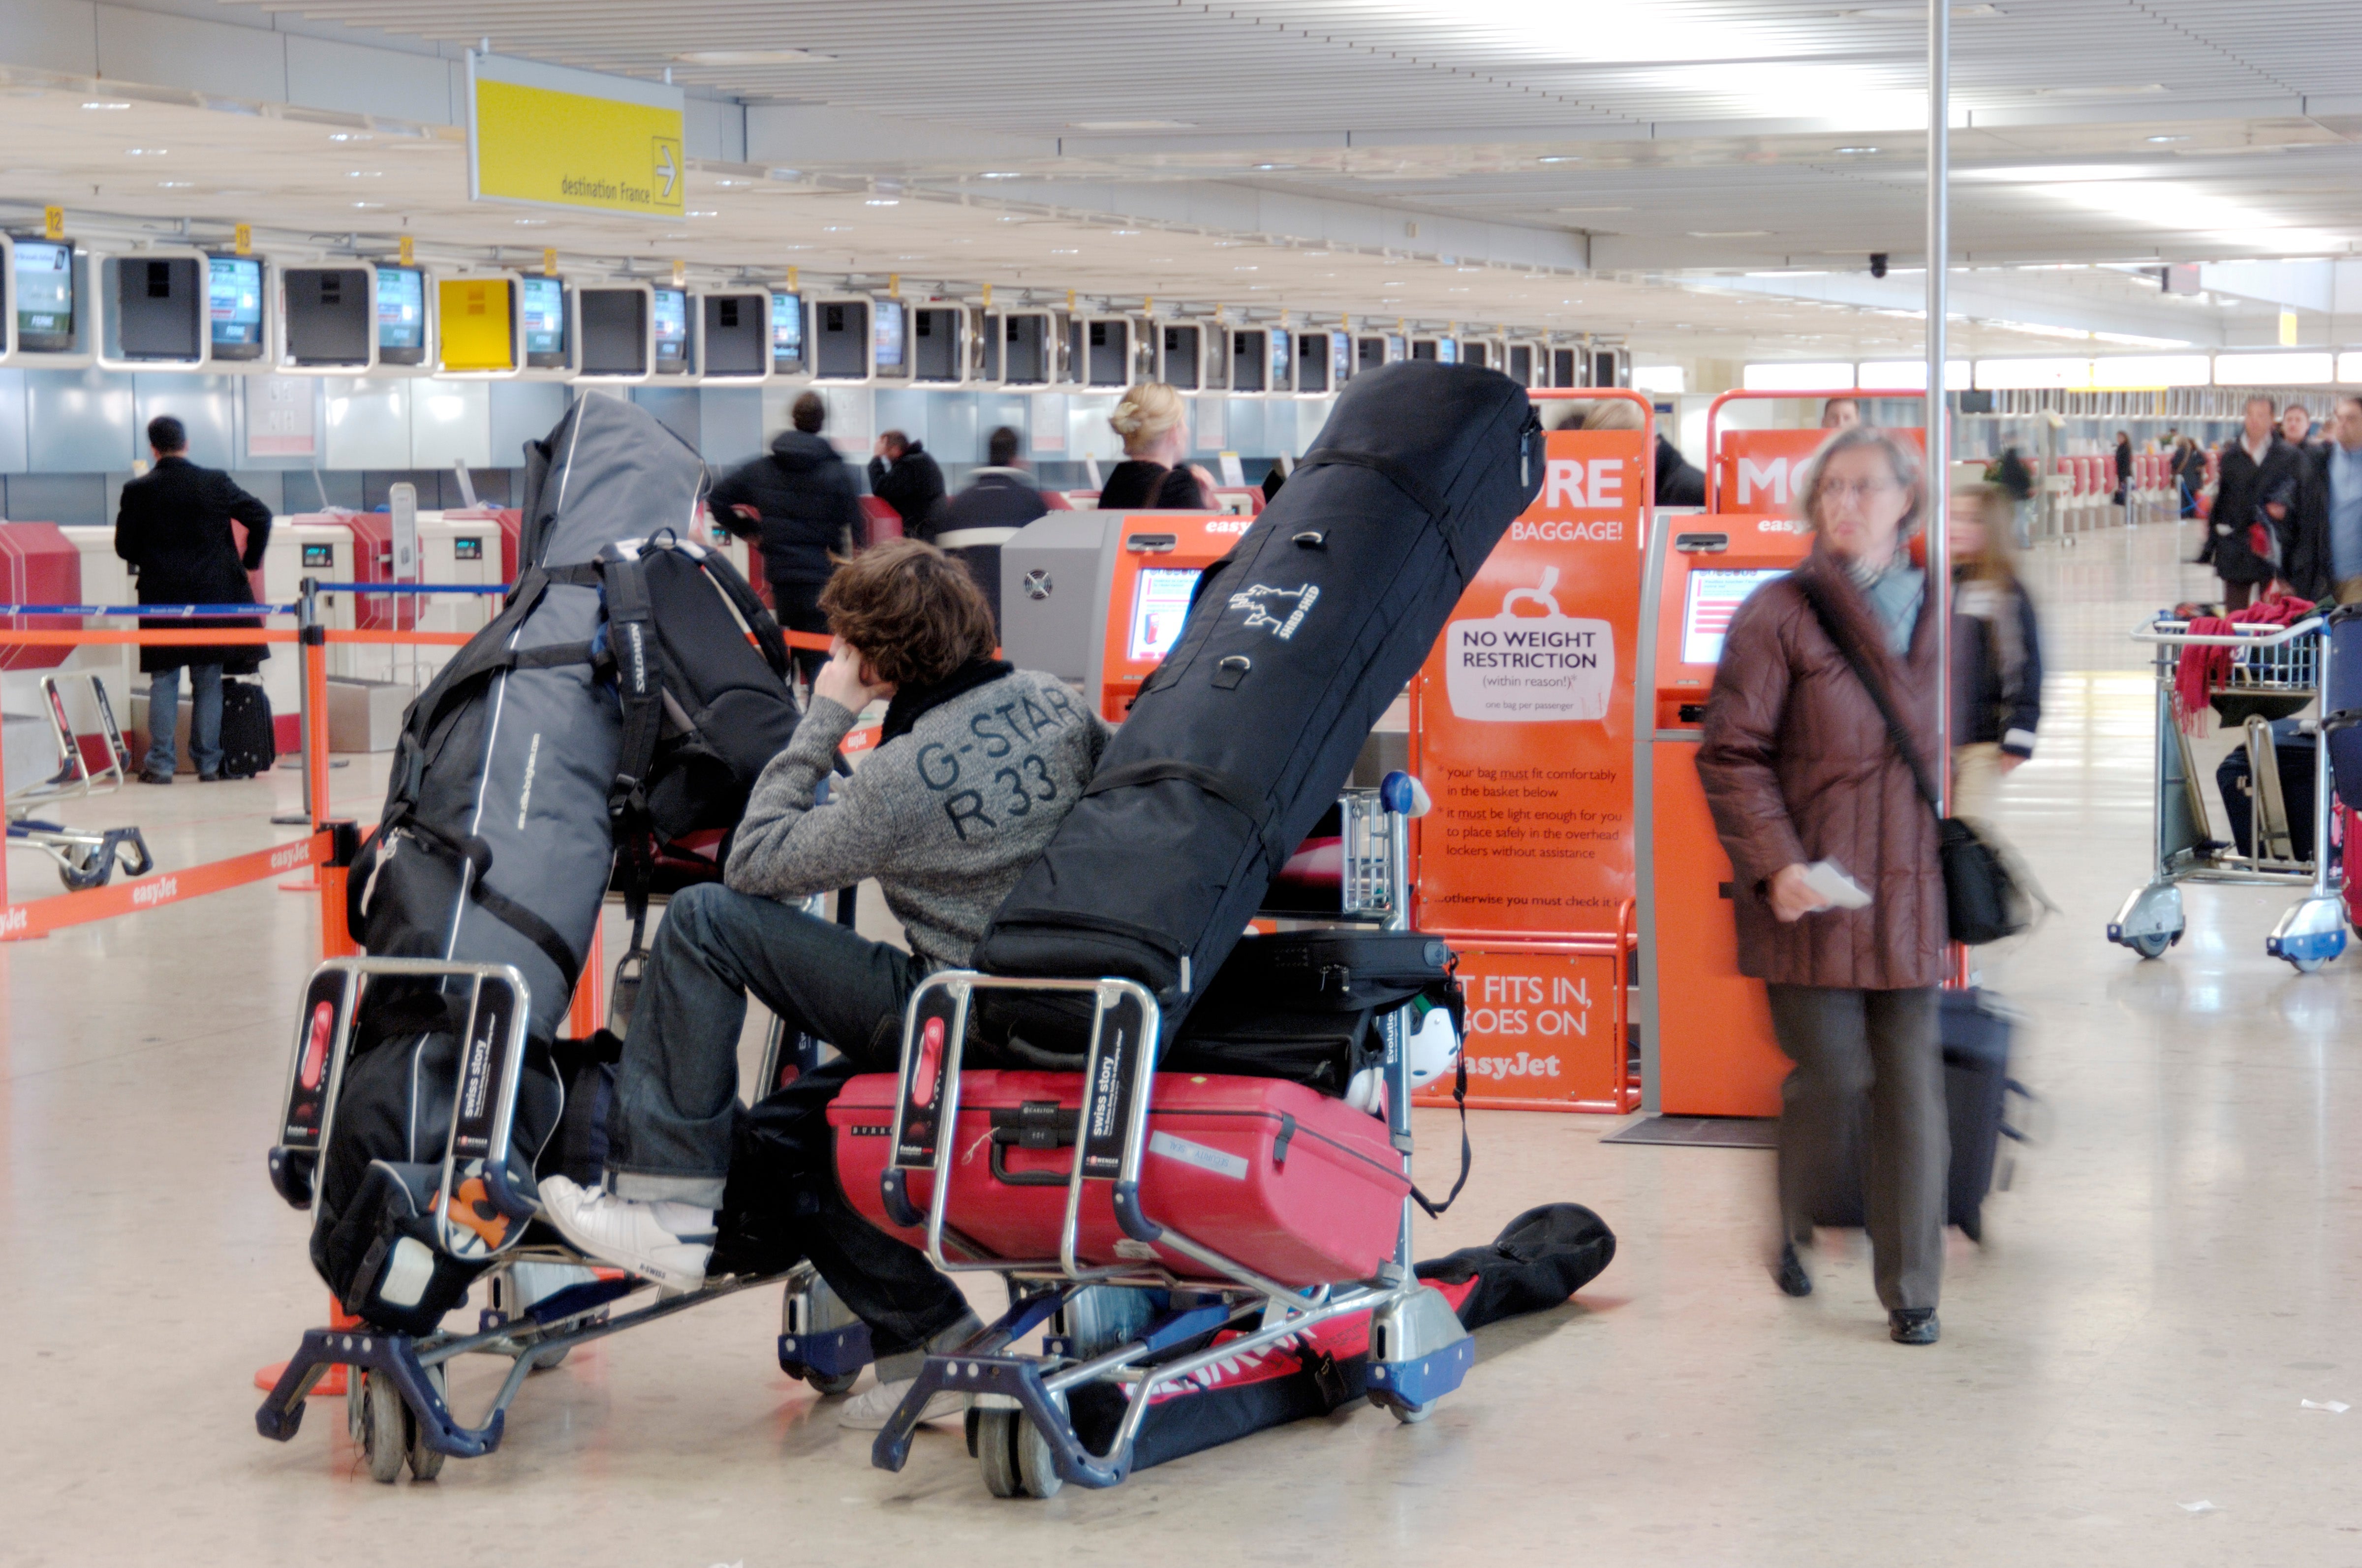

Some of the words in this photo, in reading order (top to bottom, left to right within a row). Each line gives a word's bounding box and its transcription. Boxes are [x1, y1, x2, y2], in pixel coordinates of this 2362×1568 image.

[562, 173, 617, 199] destination
[621, 182, 650, 203] France
[48, 211, 62, 231] 12
[239, 229, 249, 248] 13
[1531, 459, 1623, 508] RE
[1512, 522, 1622, 540] BAGGAGE!
[1280, 609, 1304, 639] SHRED
[1298, 585, 1319, 611] SHED
[1463, 631, 1497, 646] NO
[1504, 632, 1596, 647] WEIGHT
[630, 623, 645, 693] SALOMON
[1463, 652, 1596, 668] RESTRICTION
[1483, 674, 1521, 688] (within
[1503, 701, 1516, 710] bag
[1519, 703, 1532, 711] per
[917, 688, 1084, 791] G-STAR
[1447, 769, 1474, 780] your
[1478, 767, 1496, 781] bag
[1501, 769, 1528, 780] must
[1532, 767, 1543, 779] fit
[1547, 768, 1616, 783] comfortably
[1447, 786, 1457, 795] in
[1461, 785, 1479, 796] the
[1483, 786, 1520, 797] basket
[1523, 786, 1558, 798] below
[1447, 808, 1454, 818] it
[1458, 809, 1487, 820] must
[1491, 807, 1504, 819] be
[1508, 808, 1530, 822] light
[1534, 810, 1576, 824] enough
[1580, 809, 1596, 821] for
[1601, 812, 1621, 824] you
[1447, 827, 1459, 836] to
[1463, 826, 1492, 839] place
[1495, 826, 1525, 840] safely
[1530, 828, 1539, 837] in
[1544, 828, 1561, 838] the
[1566, 828, 1619, 840] overhead
[271, 842, 309, 871] easyJet
[1447, 844, 1488, 856] lockers
[1492, 845, 1535, 858] without
[1540, 847, 1595, 859] assistance
[133, 877, 177, 904] easyJet
[1507, 895, 1528, 907] you
[1532, 896, 1562, 906] must
[1565, 895, 1599, 907] check
[1603, 896, 1610, 907] it
[1455, 975, 1475, 1001] T
[1485, 976, 1543, 1004] FITS
[1554, 977, 1592, 1009] IN,
[1536, 1010, 1586, 1036] ON
[471, 1039, 486, 1076] story
[1098, 1056, 1114, 1093] story
[465, 1077, 478, 1118] swiss
[1093, 1095, 1107, 1137] swiss
[1169, 1140, 1185, 1154] SEAL
[1194, 1150, 1230, 1168] SECURITY
